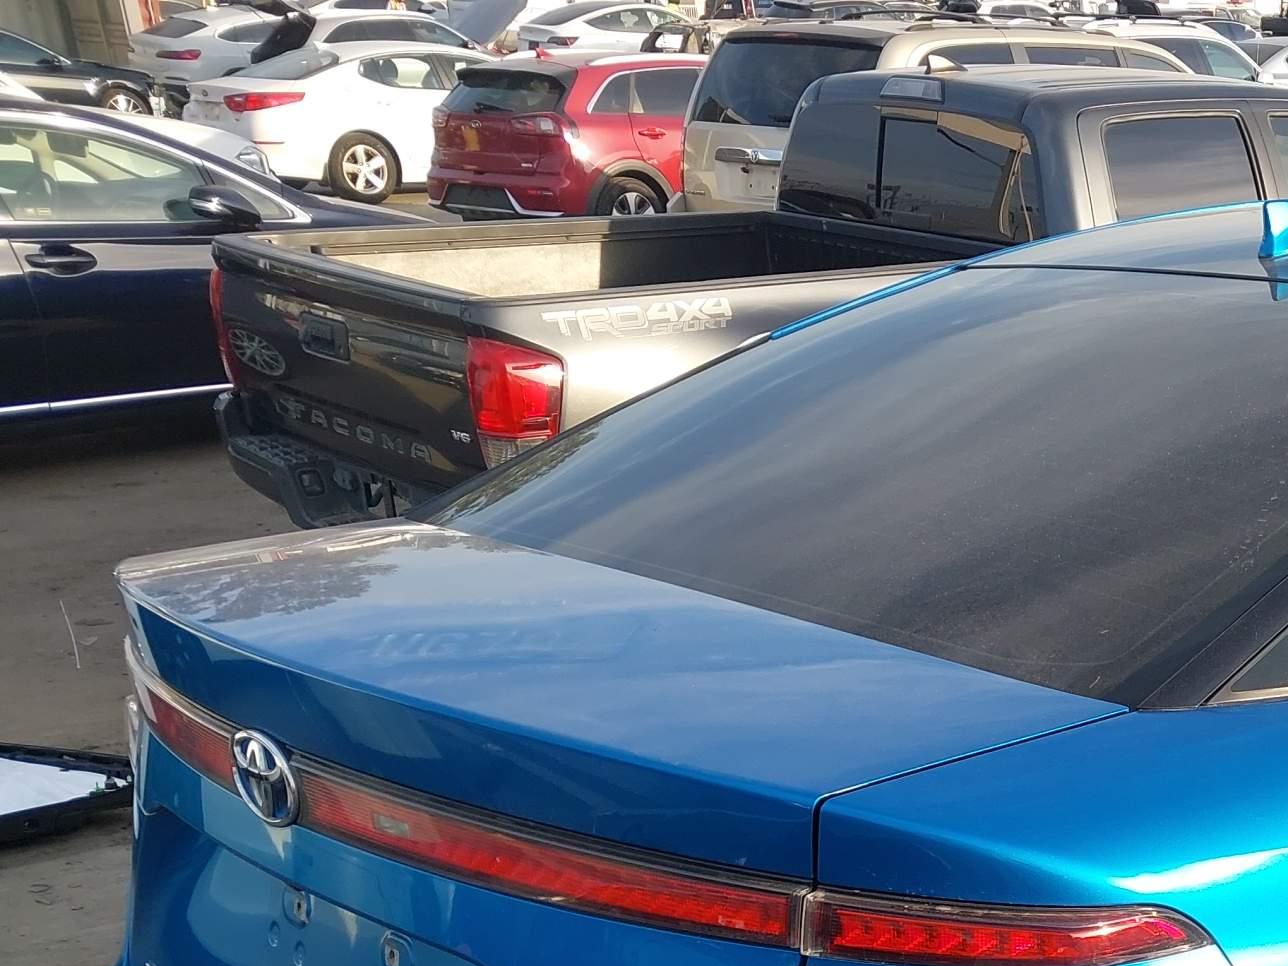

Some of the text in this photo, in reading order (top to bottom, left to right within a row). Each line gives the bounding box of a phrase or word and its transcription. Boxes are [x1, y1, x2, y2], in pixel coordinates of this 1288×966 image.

[541, 305, 649, 342] TRD
[650, 318, 728, 335] SPORT
[286, 398, 432, 464] TACOMA
[449, 429, 471, 444] V6
